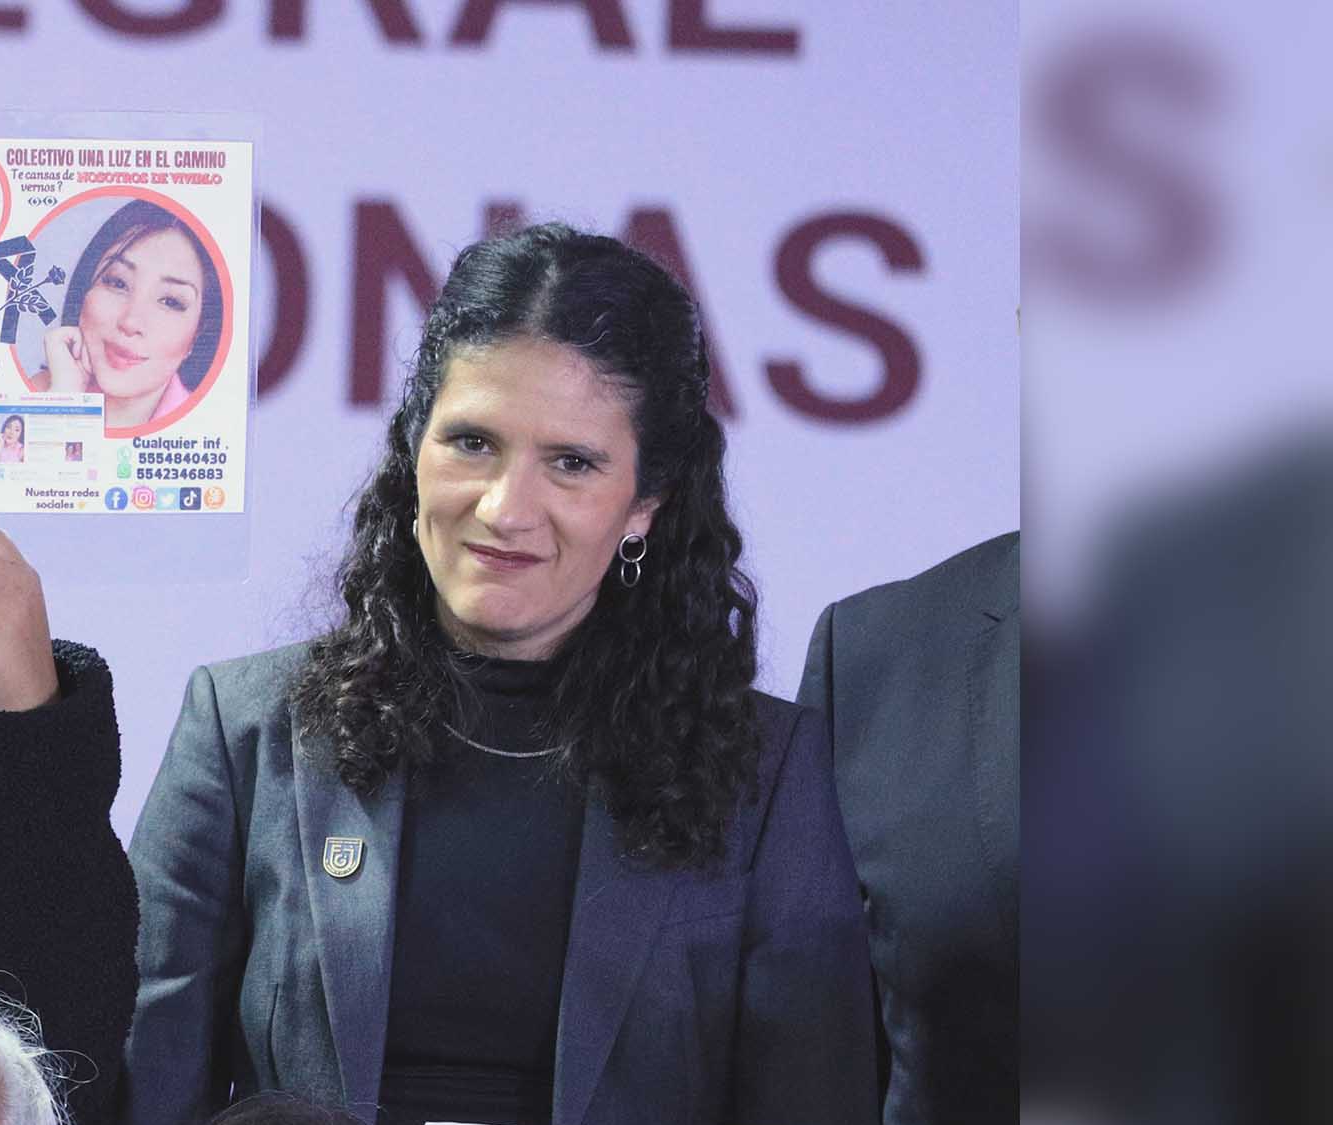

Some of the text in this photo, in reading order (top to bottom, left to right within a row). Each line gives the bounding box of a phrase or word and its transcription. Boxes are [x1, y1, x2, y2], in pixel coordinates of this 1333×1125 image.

[6, 148, 226, 169] COLECTIVO UNA LUZ EN EL CAMINO
[11, 169, 75, 181] Te cansas de
[20, 183, 56, 193] vernos
[133, 436, 198, 452] Cualquier
[138, 452, 227, 466] 5554840430
[136, 468, 224, 481] 5542346883
[25, 487, 99, 497] Nuestras redes
[36, 499, 74, 509] sociales
